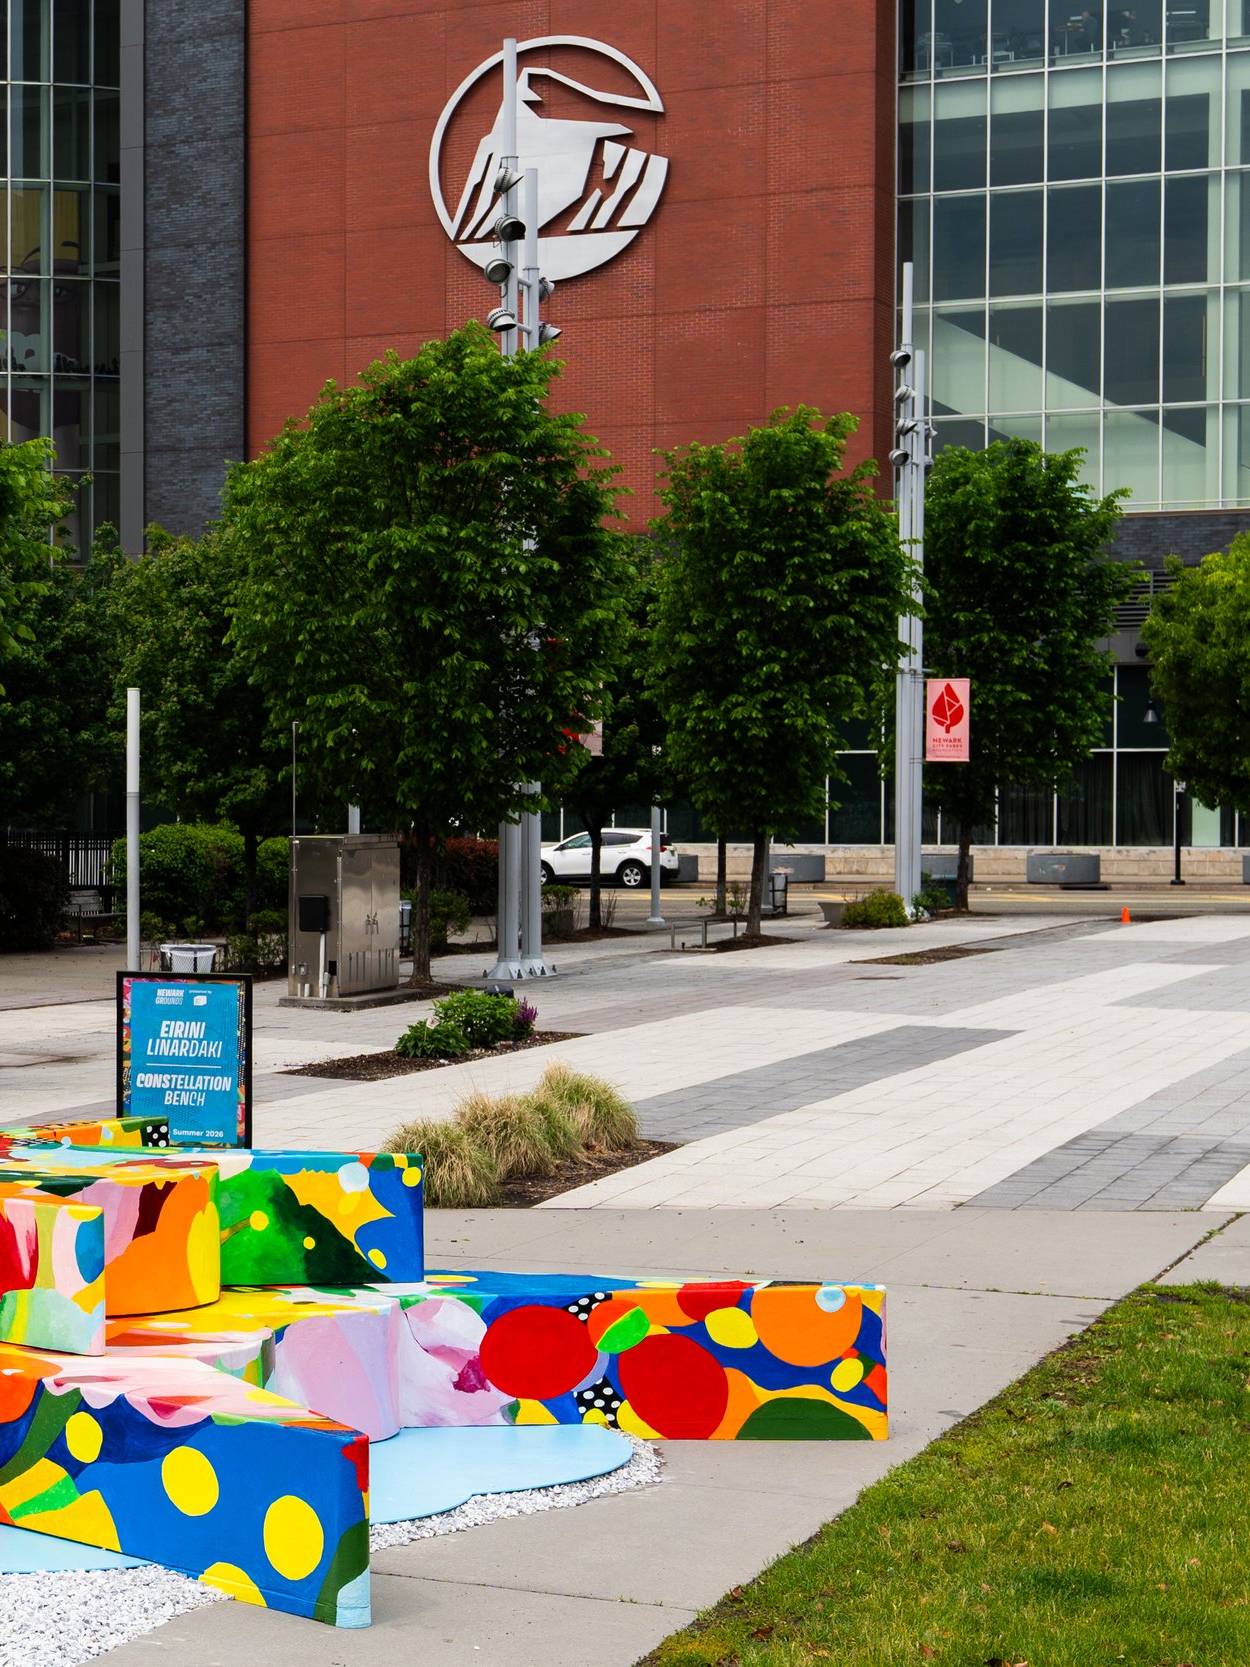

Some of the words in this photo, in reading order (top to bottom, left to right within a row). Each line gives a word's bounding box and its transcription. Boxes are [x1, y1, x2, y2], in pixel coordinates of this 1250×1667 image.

[157, 988, 184, 997] NEWARK
[155, 997, 183, 1005] GROUNDS
[160, 1020, 205, 1039] EIRINI
[147, 1038, 222, 1058] LINARDAKI
[136, 1073, 232, 1091] CONSTELLATION
[164, 1090, 205, 1106] BENCH
[173, 1128, 204, 1137] Summer
[205, 1130, 224, 1138] 2026
